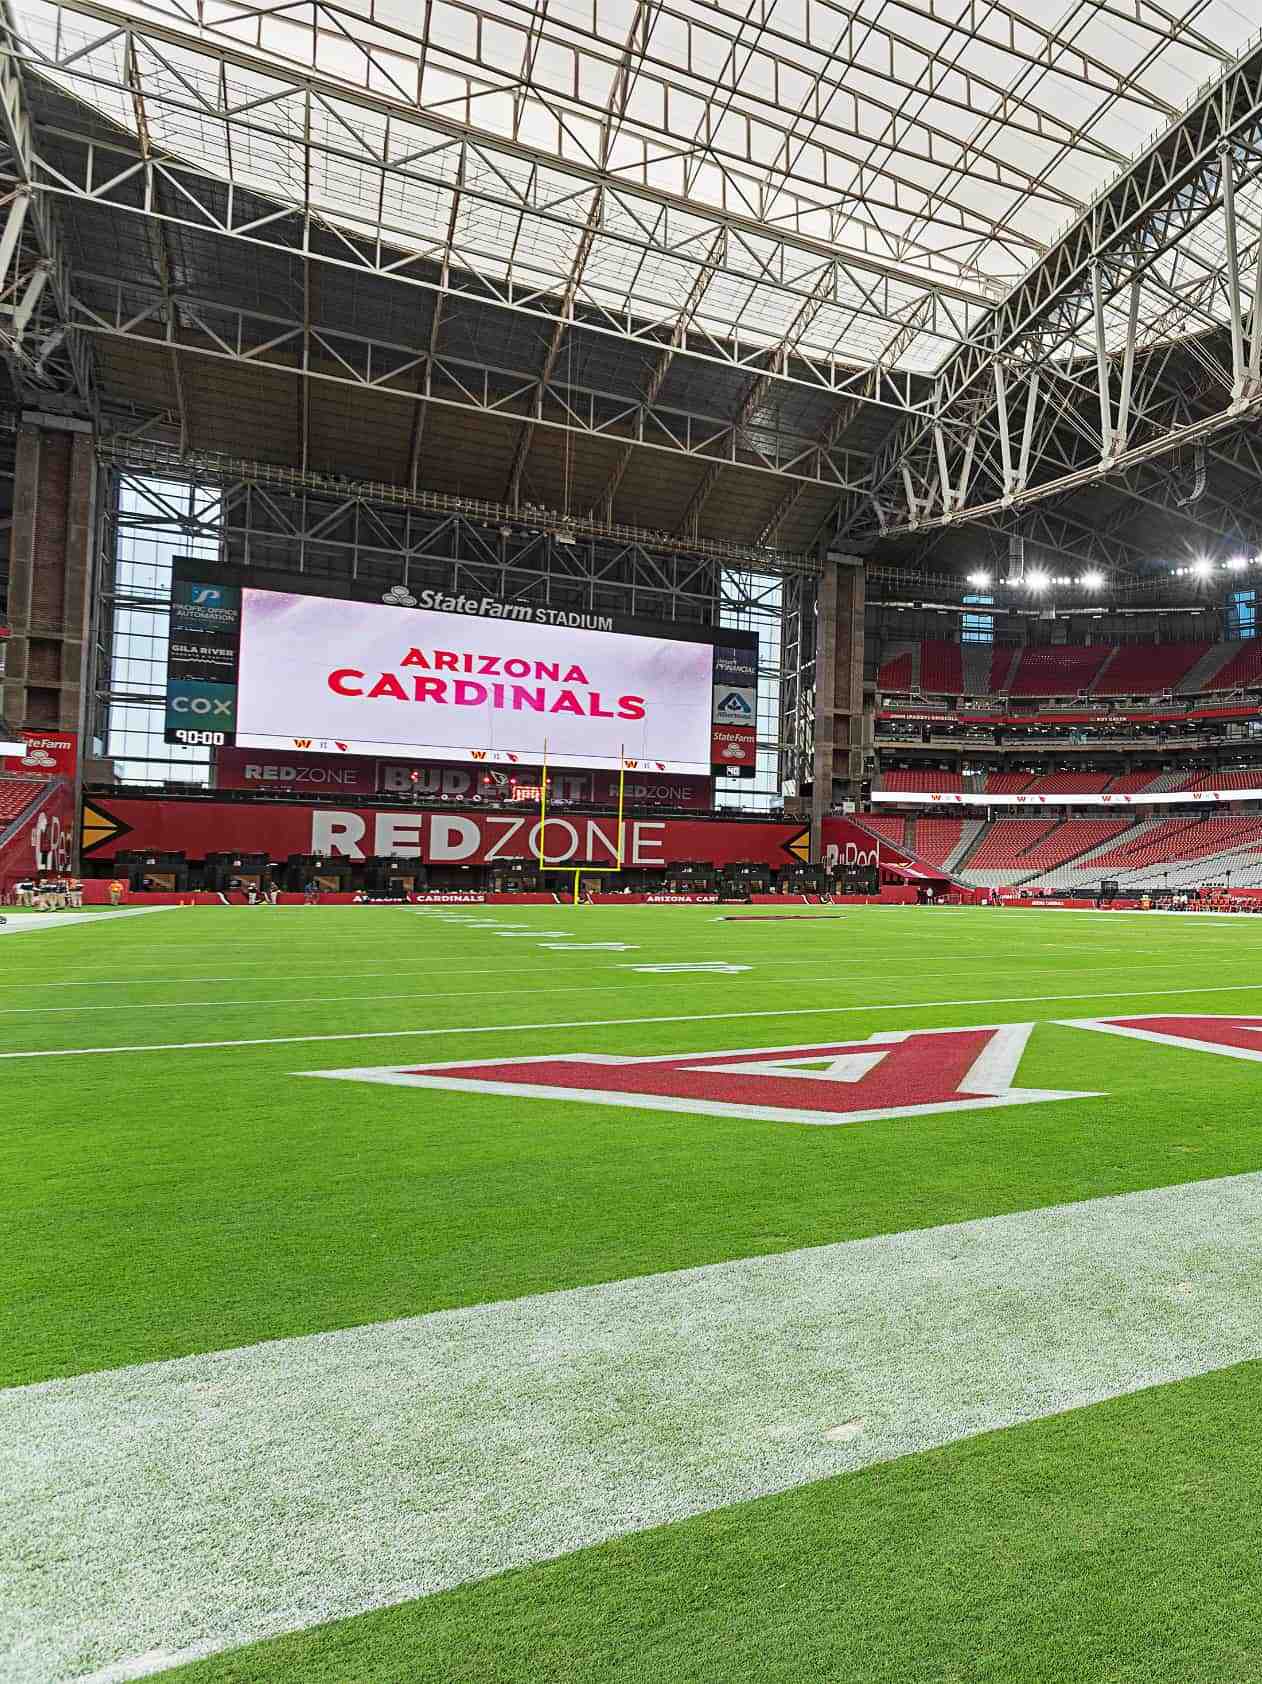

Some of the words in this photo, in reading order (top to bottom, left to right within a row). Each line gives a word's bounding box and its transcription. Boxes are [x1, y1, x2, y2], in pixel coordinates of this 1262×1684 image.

[535, 608, 613, 631] STADIUM
[172, 645, 198, 653] GILA
[200, 648, 233, 657] RIVER
[400, 647, 589, 685] ARIZONA
[172, 696, 232, 715] COX
[328, 668, 646, 720] CARDINALS
[176, 730, 224, 745] 90:00
[244, 764, 357, 784] REDZONE
[385, 766, 470, 793] BUD
[311, 809, 666, 865] REDZONE
